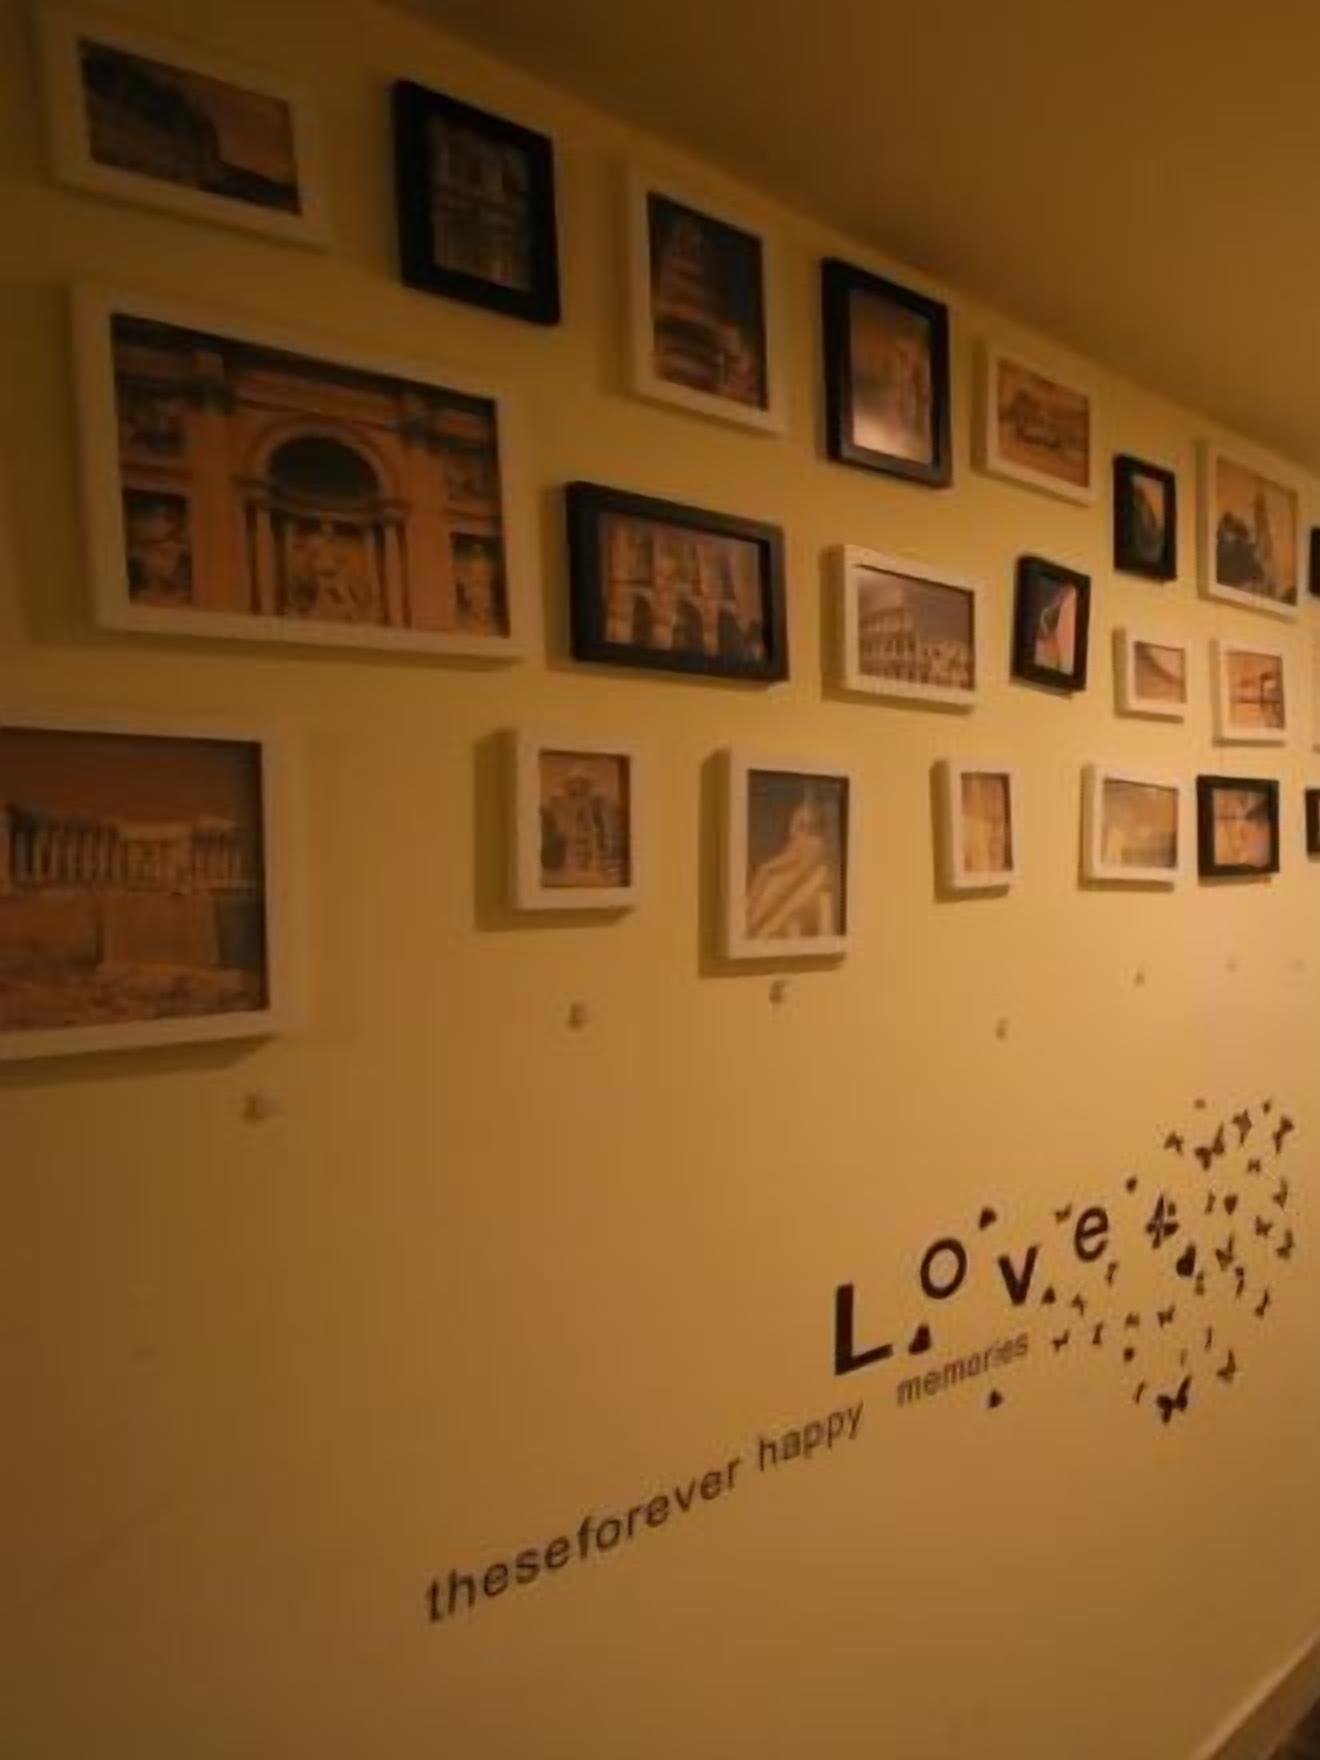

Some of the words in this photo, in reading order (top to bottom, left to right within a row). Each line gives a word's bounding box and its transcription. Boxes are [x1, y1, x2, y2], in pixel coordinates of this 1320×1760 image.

[834, 1206, 1109, 1375] Love
[758, 1402, 863, 1471] happy
[896, 1334, 1028, 1407] memories
